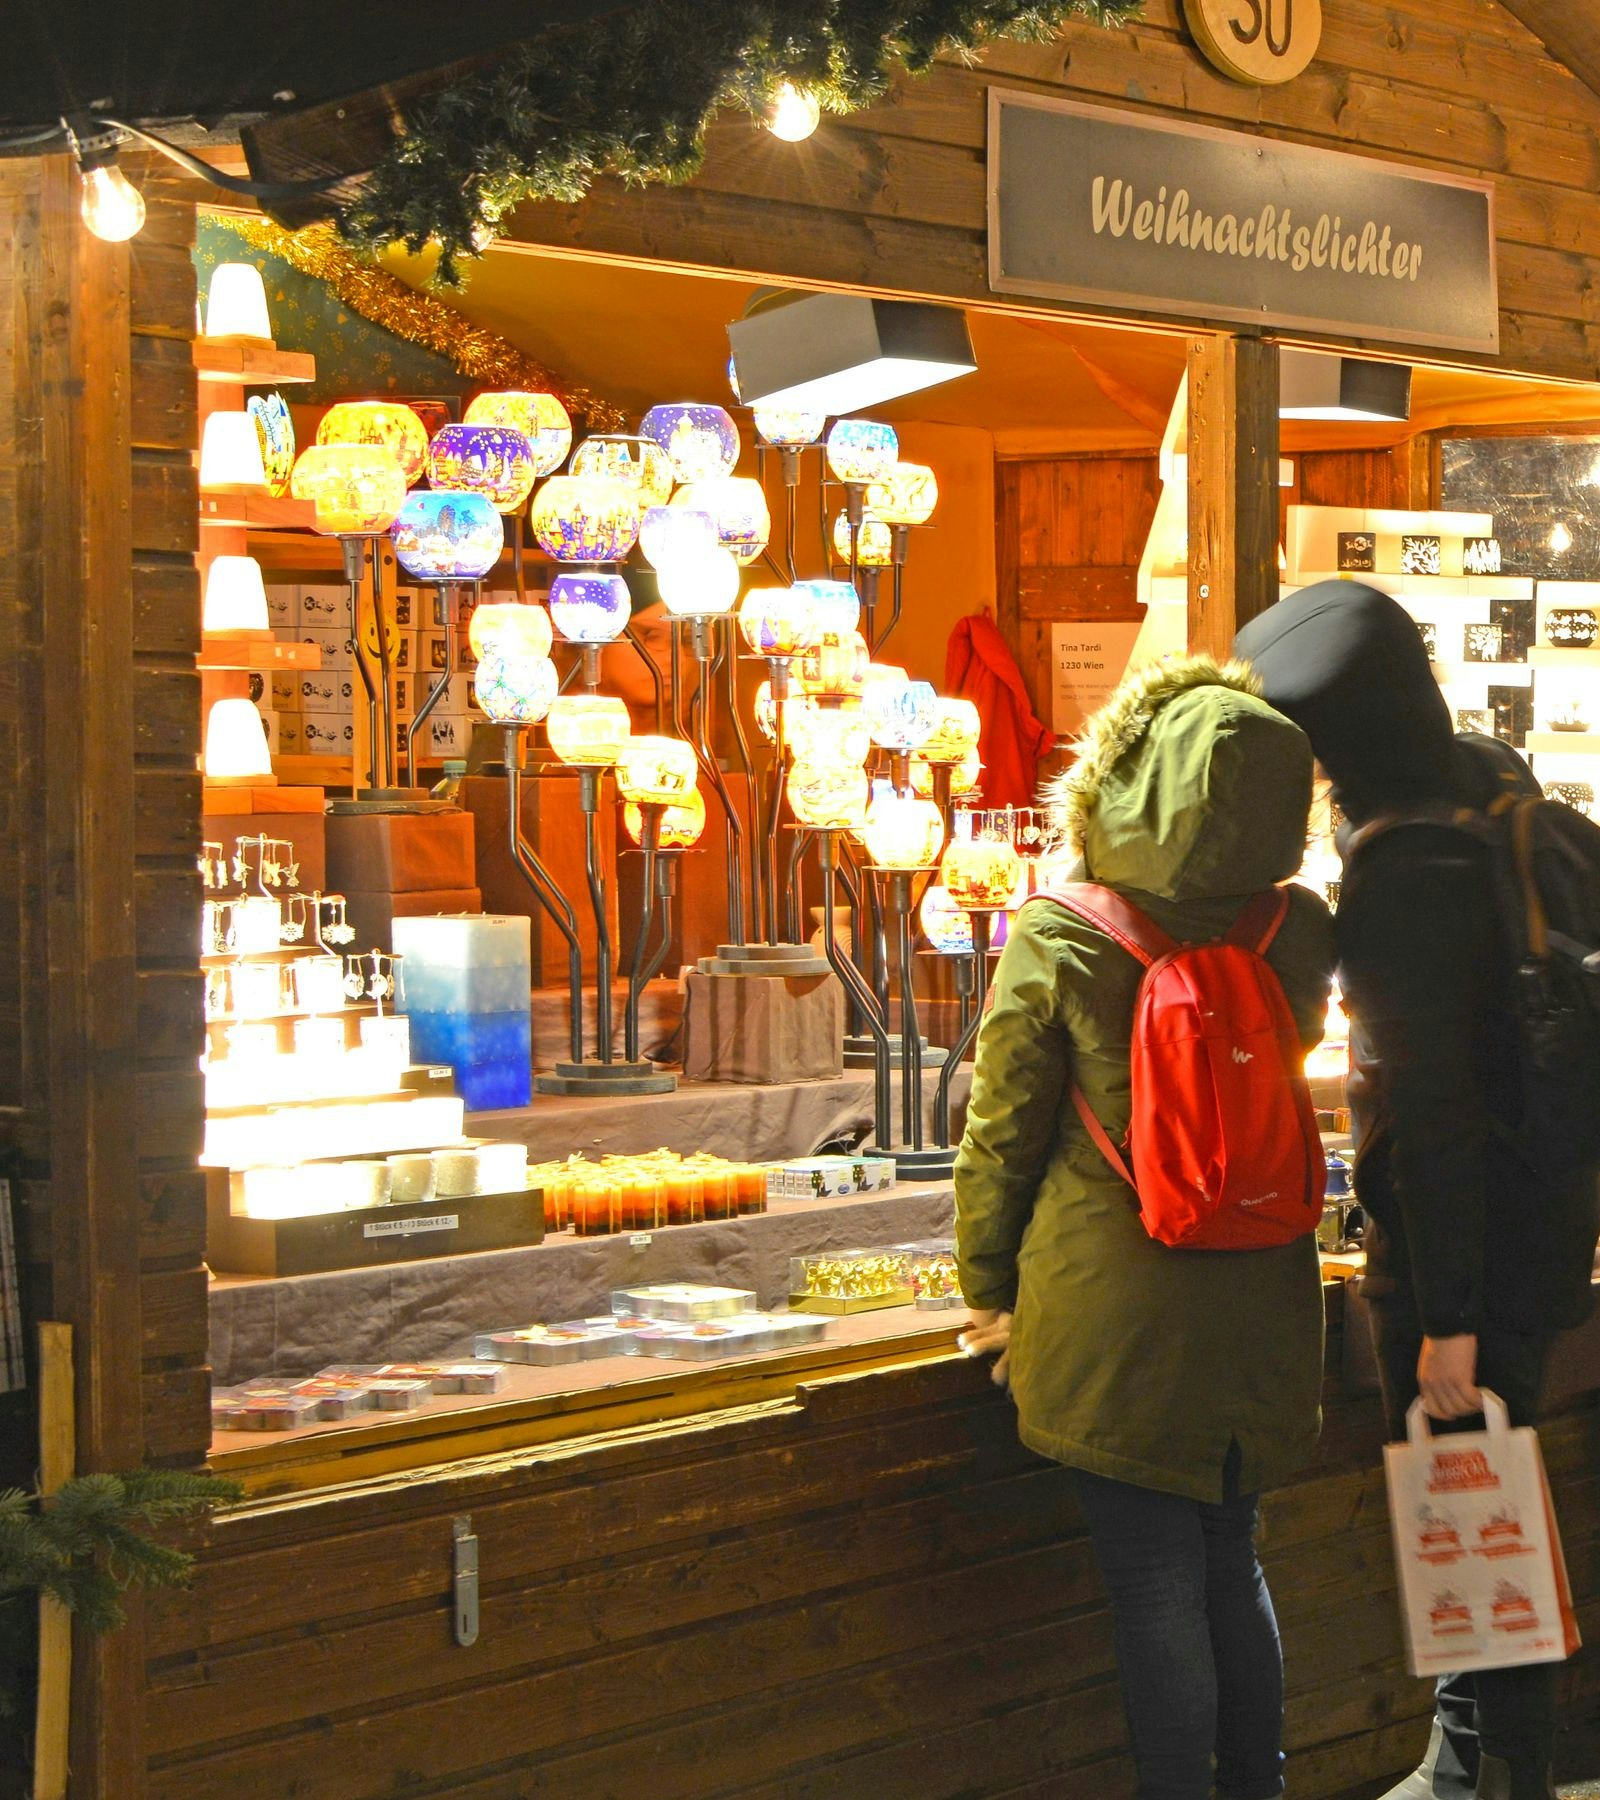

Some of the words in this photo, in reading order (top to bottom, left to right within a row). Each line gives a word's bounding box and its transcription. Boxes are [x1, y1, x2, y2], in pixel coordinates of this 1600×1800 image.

[1092, 176, 1422, 281] Weihnachtslichter
[1061, 643, 1078, 652] Tina
[1081, 643, 1102, 652] Tardi
[1060, 661, 1082, 670] 1230
[1083, 661, 1105, 670] Wien
[375, 1223, 392, 1231] Stück
[416, 1218, 433, 1227] Stück
